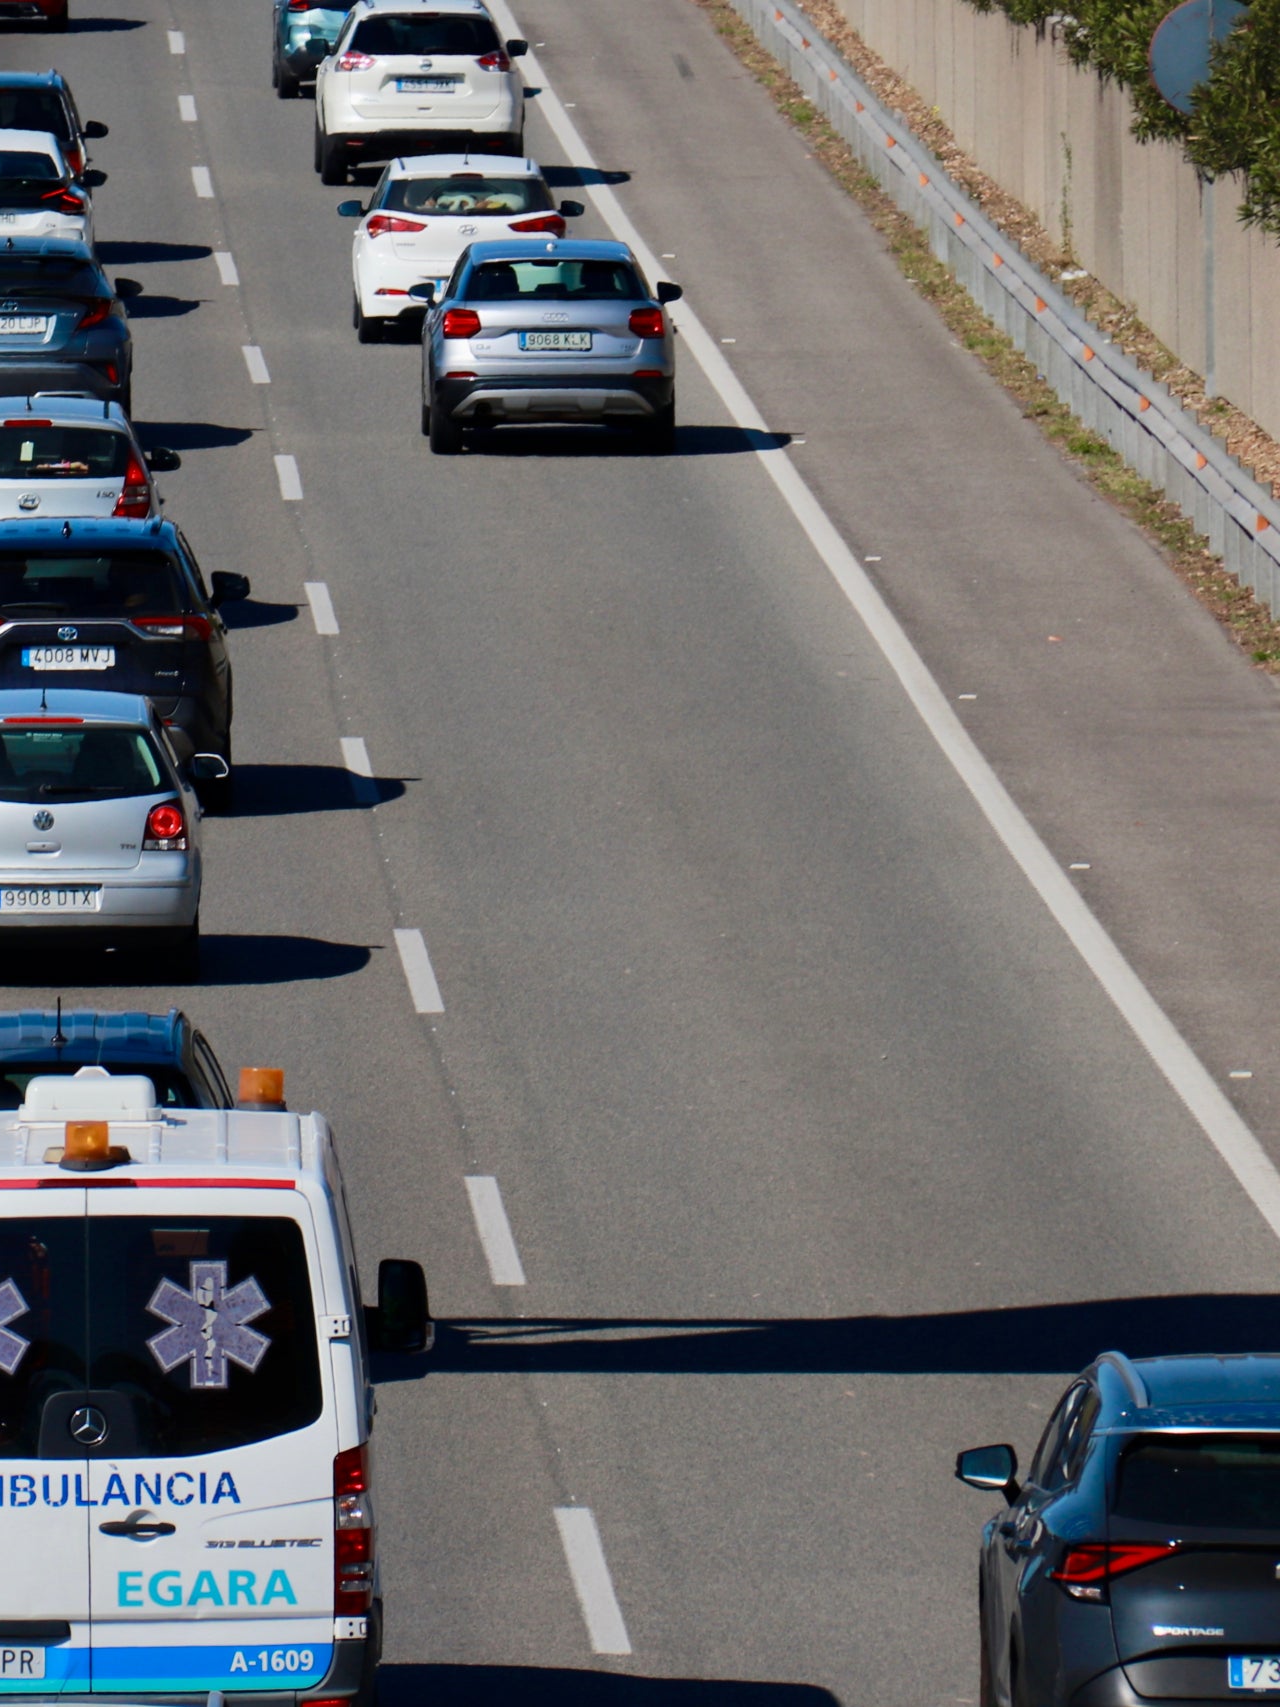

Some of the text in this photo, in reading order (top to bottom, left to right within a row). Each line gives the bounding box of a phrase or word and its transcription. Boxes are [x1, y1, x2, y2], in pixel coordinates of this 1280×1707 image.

[19, 317, 41, 329] LJP
[528, 334, 588, 346] 9068 KLK
[34, 648, 111, 664] 4008 MVJ
[4, 890, 91, 906] 9908 DTX
[117, 1569, 299, 1608] EGARA
[1153, 1625, 1224, 1636] SPORTAGE
[229, 1649, 315, 1673] A-1609
[1249, 1658, 1280, 1683] 73
